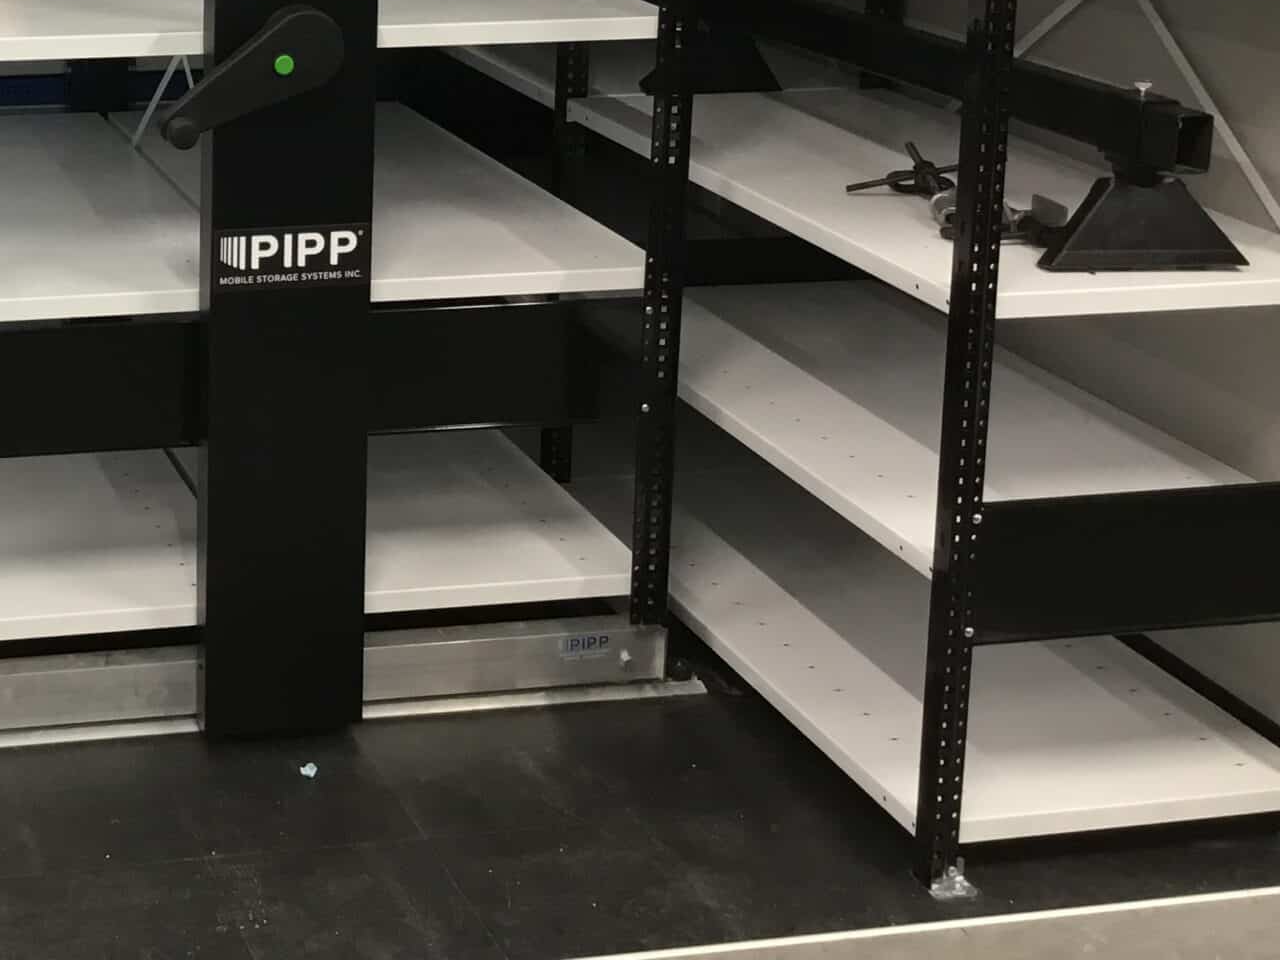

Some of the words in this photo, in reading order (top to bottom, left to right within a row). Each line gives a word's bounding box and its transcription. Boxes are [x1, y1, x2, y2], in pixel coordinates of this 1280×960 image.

[250, 230, 358, 270] PIPP
[219, 274, 254, 286] MOBILE
[256, 272, 299, 284] STORAGE
[300, 270, 343, 281] SYSTEMS
[344, 269, 363, 279] INC.
